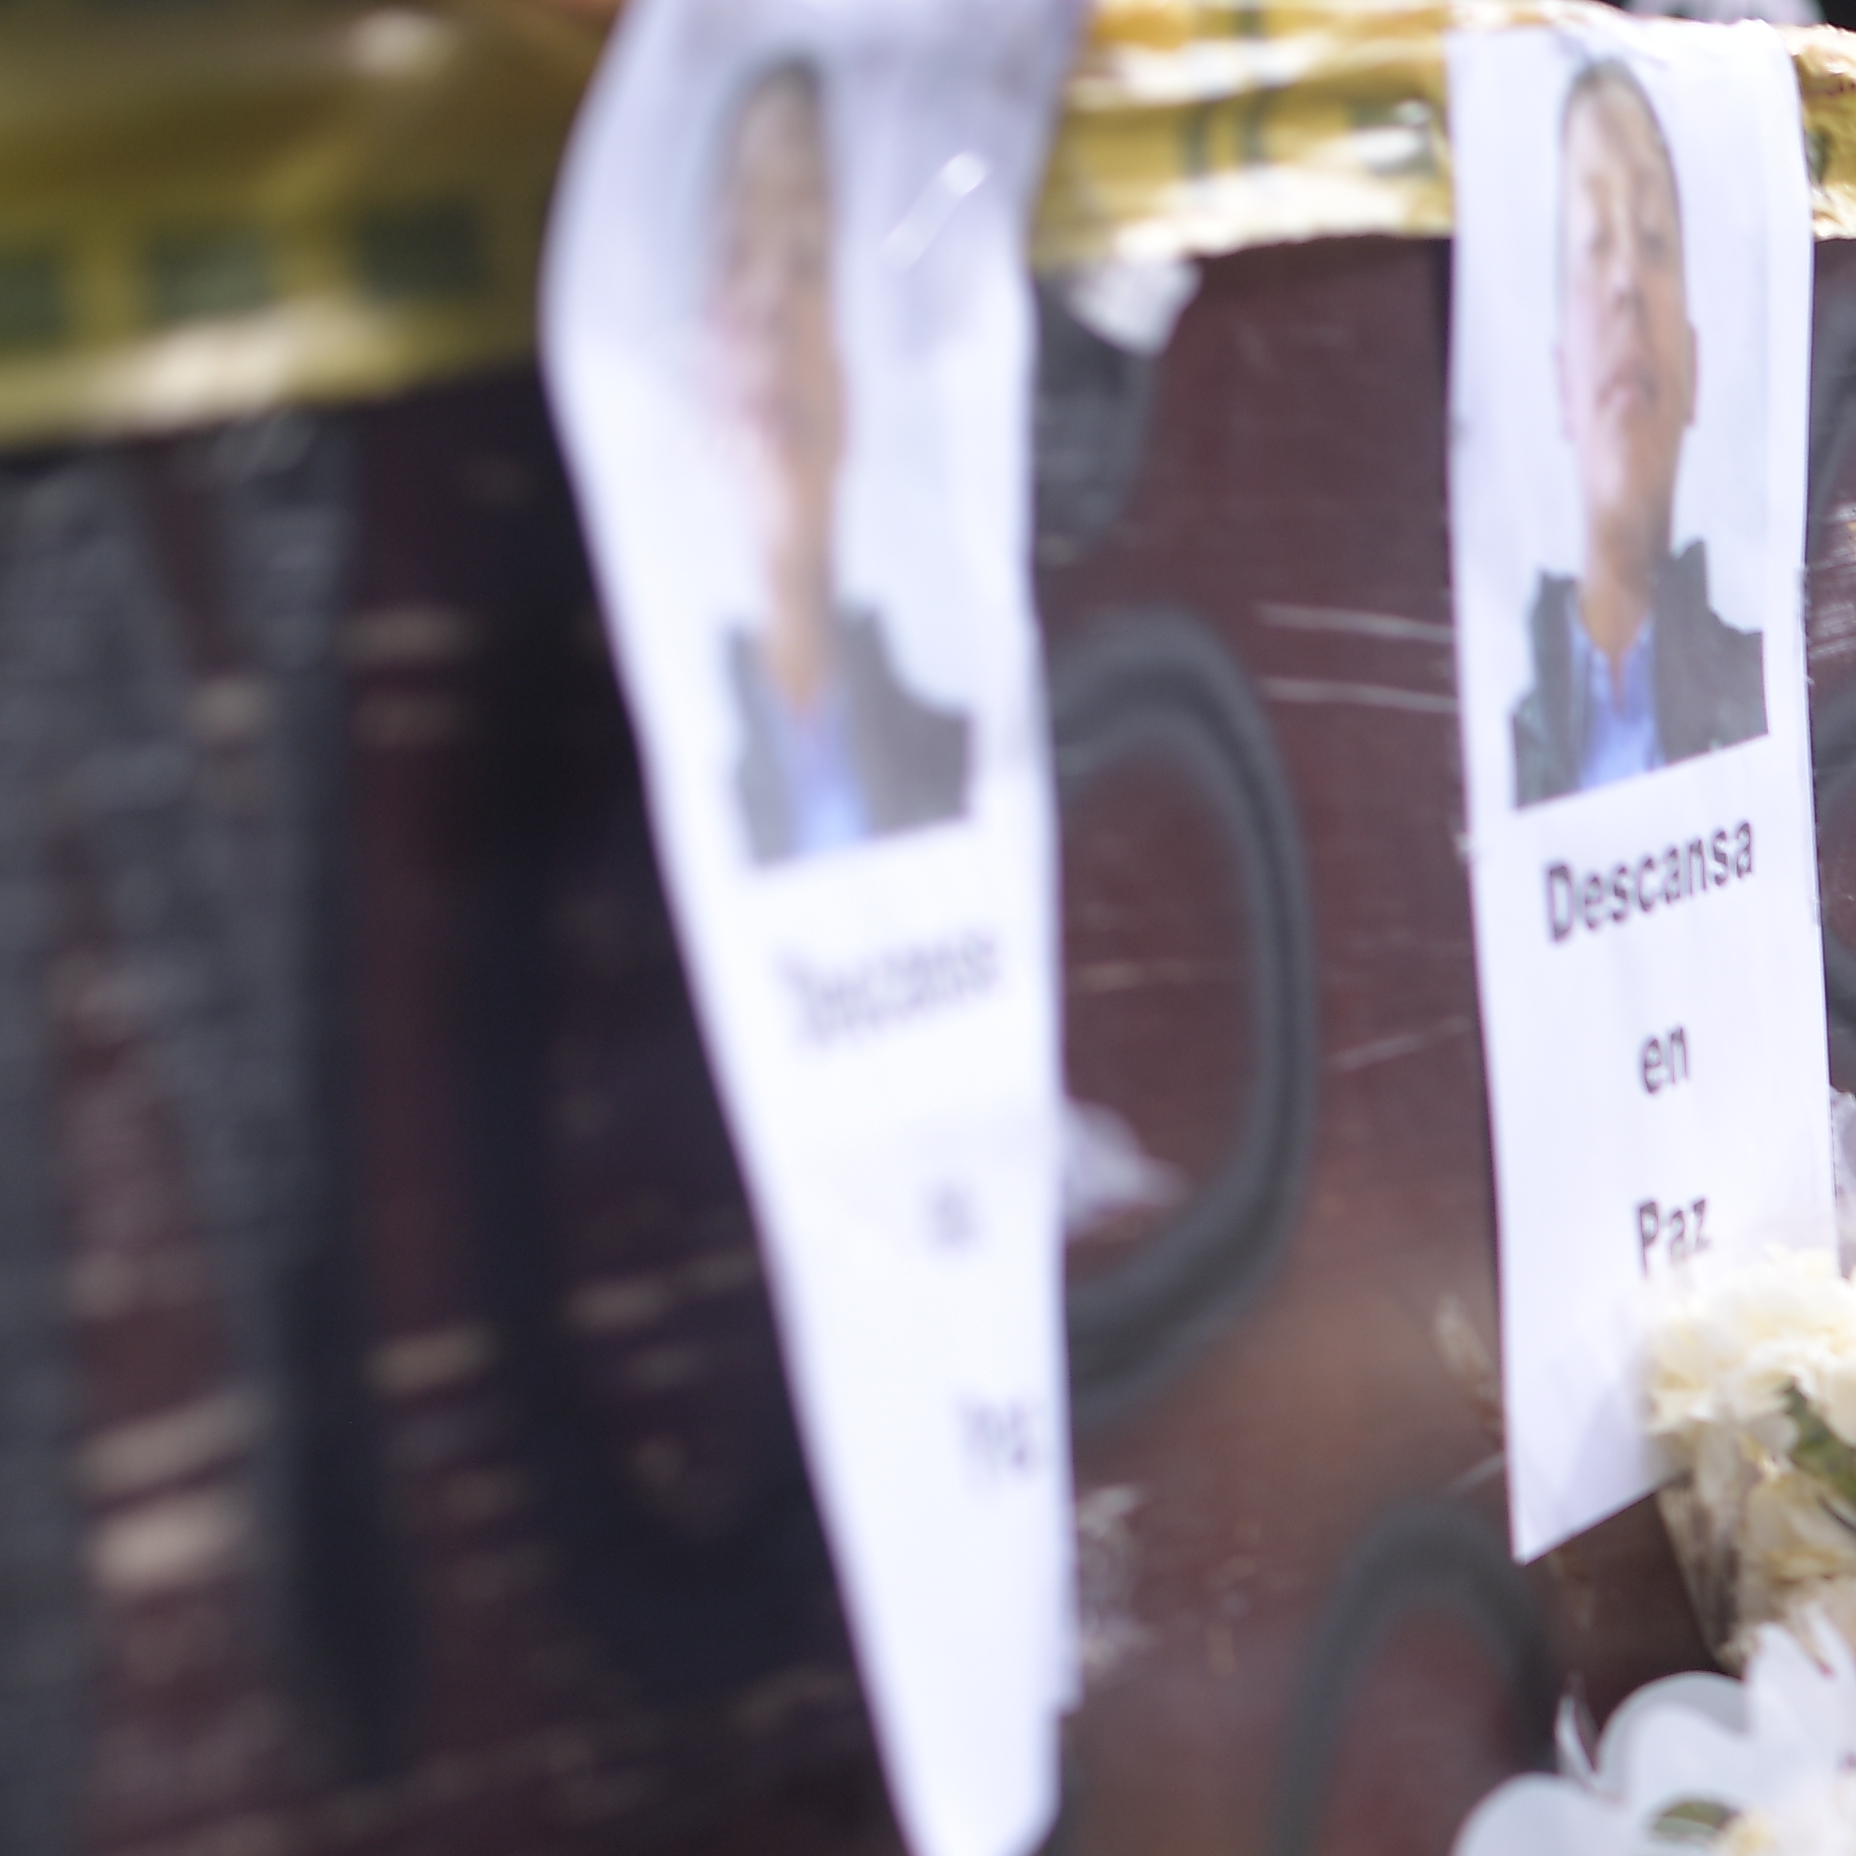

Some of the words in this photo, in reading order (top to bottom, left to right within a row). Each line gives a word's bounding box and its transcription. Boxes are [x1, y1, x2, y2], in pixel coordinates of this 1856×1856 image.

[1544, 818, 1756, 944] Descansa
[1640, 1023, 1690, 1094] en
[1635, 1197, 1711, 1278] Paz
